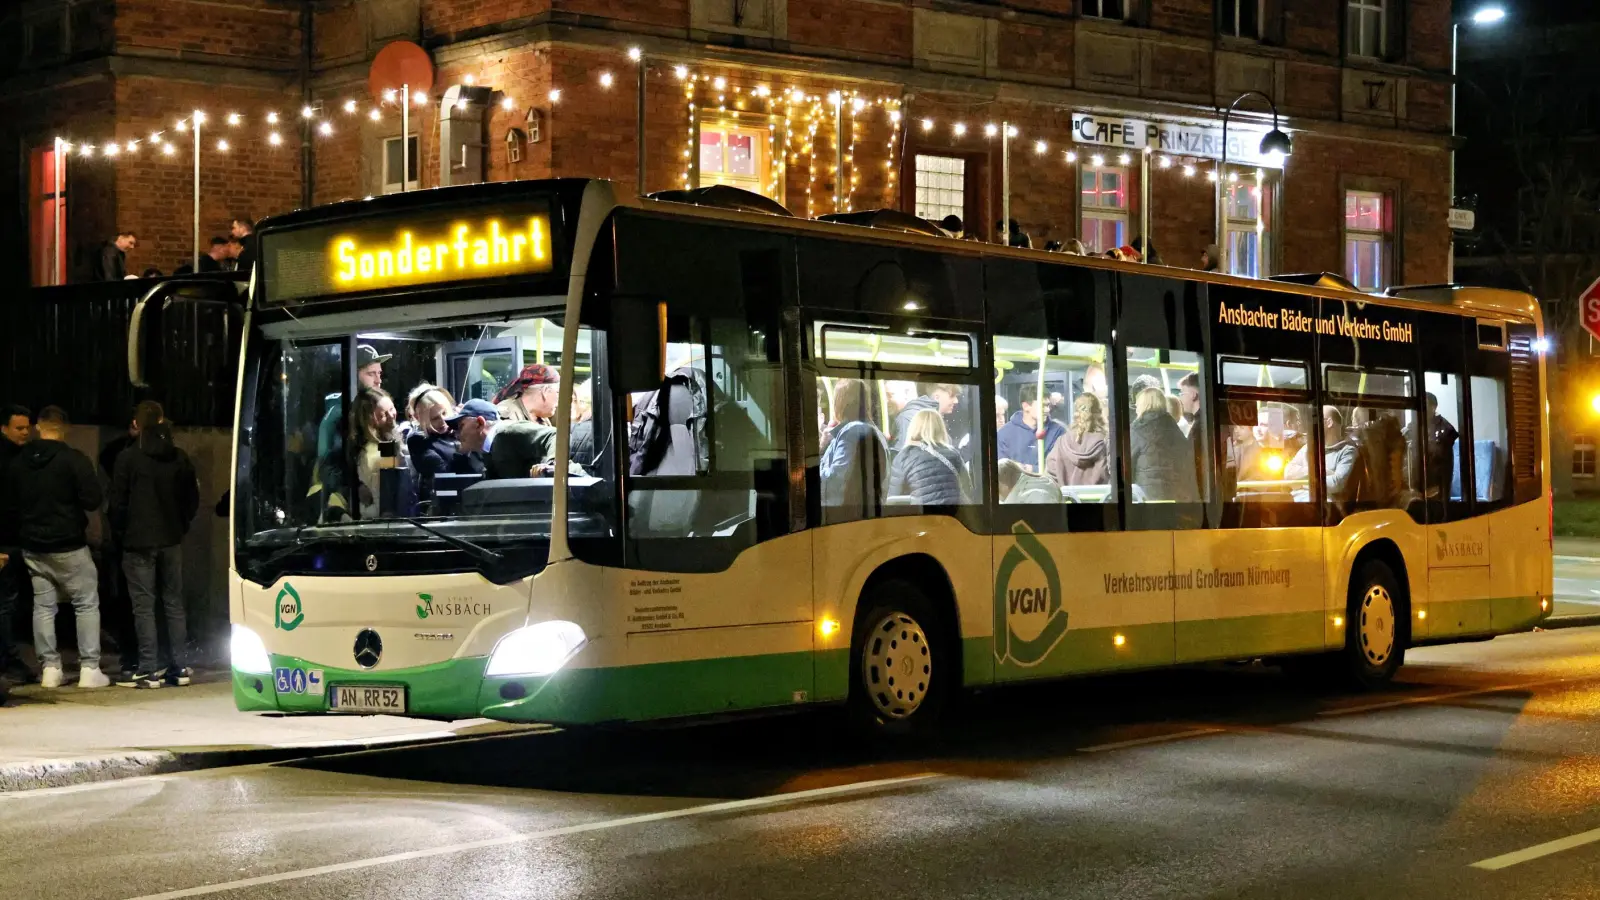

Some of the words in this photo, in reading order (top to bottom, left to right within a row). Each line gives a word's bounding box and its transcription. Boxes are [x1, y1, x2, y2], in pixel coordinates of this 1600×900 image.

[1080, 117, 1135, 145] CAFÉ
[338, 216, 545, 281] Sonderfahrt
[1219, 301, 1278, 329] Ansbacher
[1281, 308, 1312, 333] Bäder
[1316, 315, 1335, 336] und
[1337, 315, 1380, 340] Verkehrs
[1383, 320, 1413, 343] GmbH
[1441, 542, 1483, 557] ANSBACH
[1103, 569, 1193, 594] Verkehrsverbund
[1196, 568, 1245, 589] Großraum
[1247, 565, 1291, 588] Nürnberg
[280, 604, 296, 614] VGN
[424, 600, 491, 616] ANSBACH
[1008, 586, 1047, 615] VGN
[341, 689, 357, 706] AN
